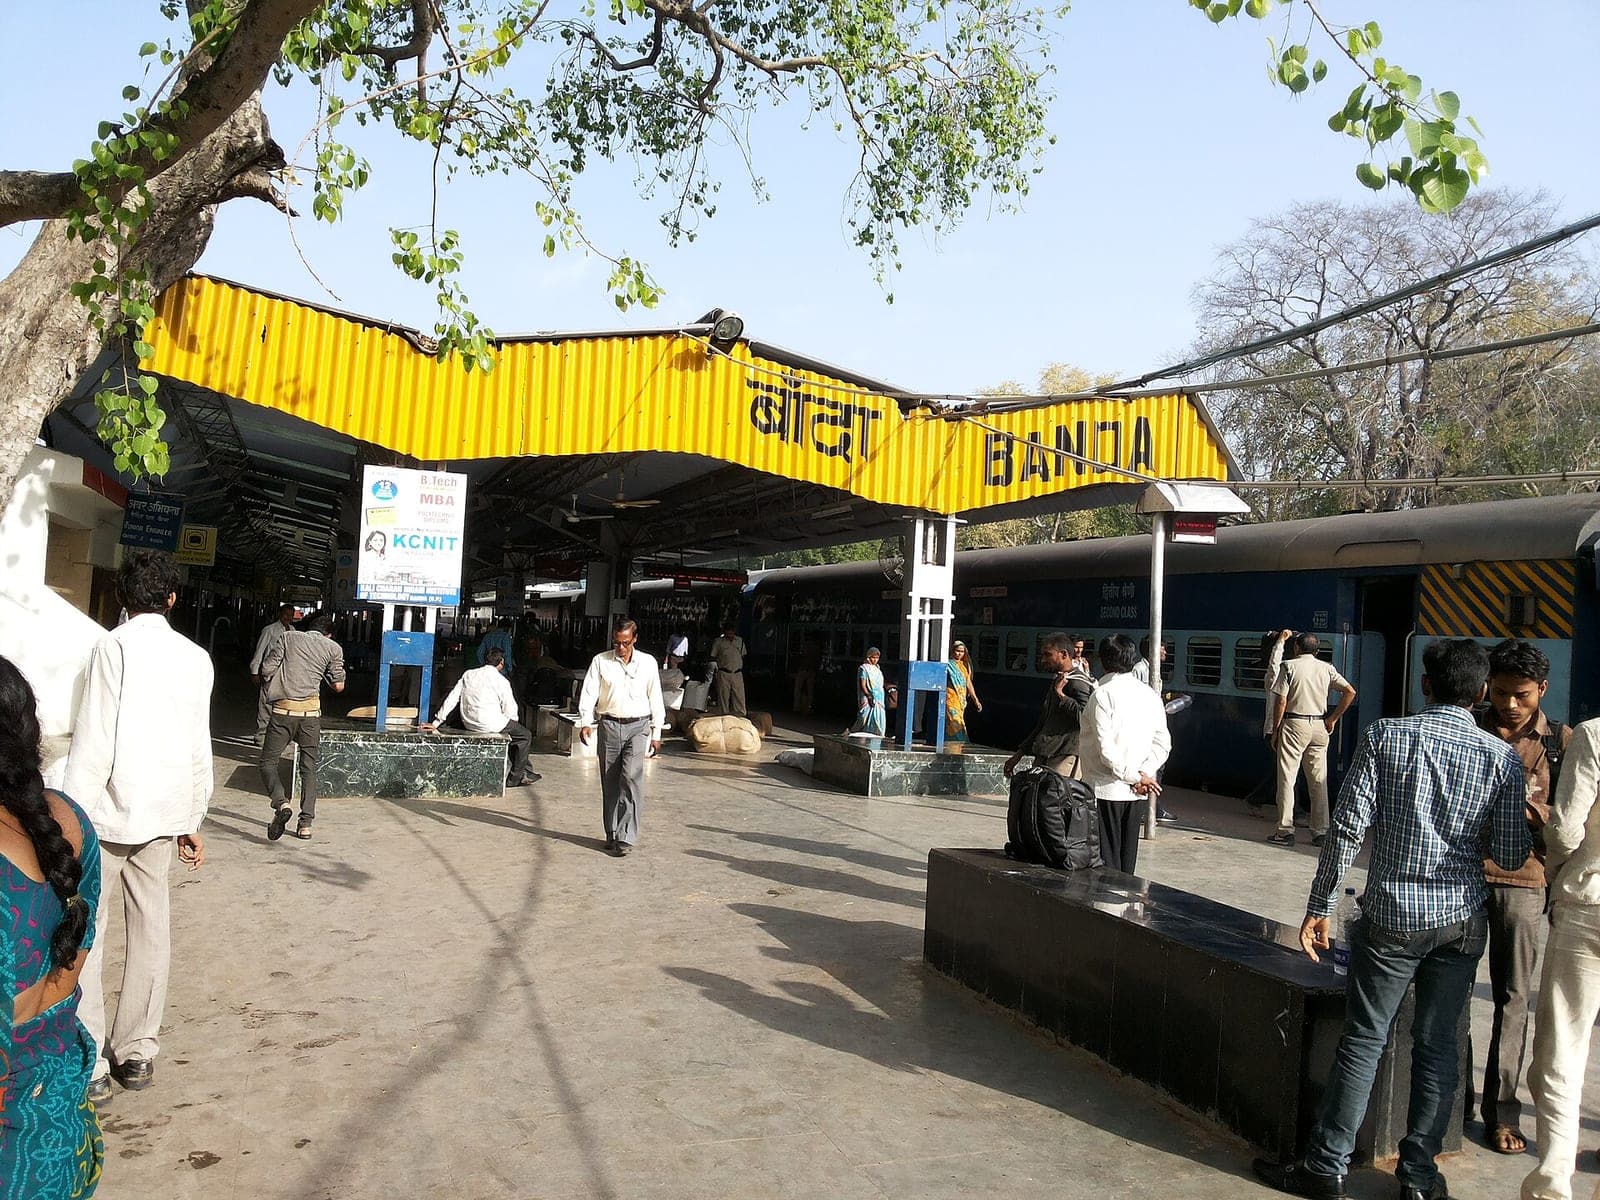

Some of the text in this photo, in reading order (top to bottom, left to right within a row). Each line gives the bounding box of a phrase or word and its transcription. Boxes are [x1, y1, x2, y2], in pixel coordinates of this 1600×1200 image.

[984, 416, 1155, 486] BANDA
[420, 474, 457, 487] B.Tech
[419, 494, 455, 507] MBA
[393, 534, 459, 551] KCNIT
[1100, 605, 1137, 618] SECOND CLASS
